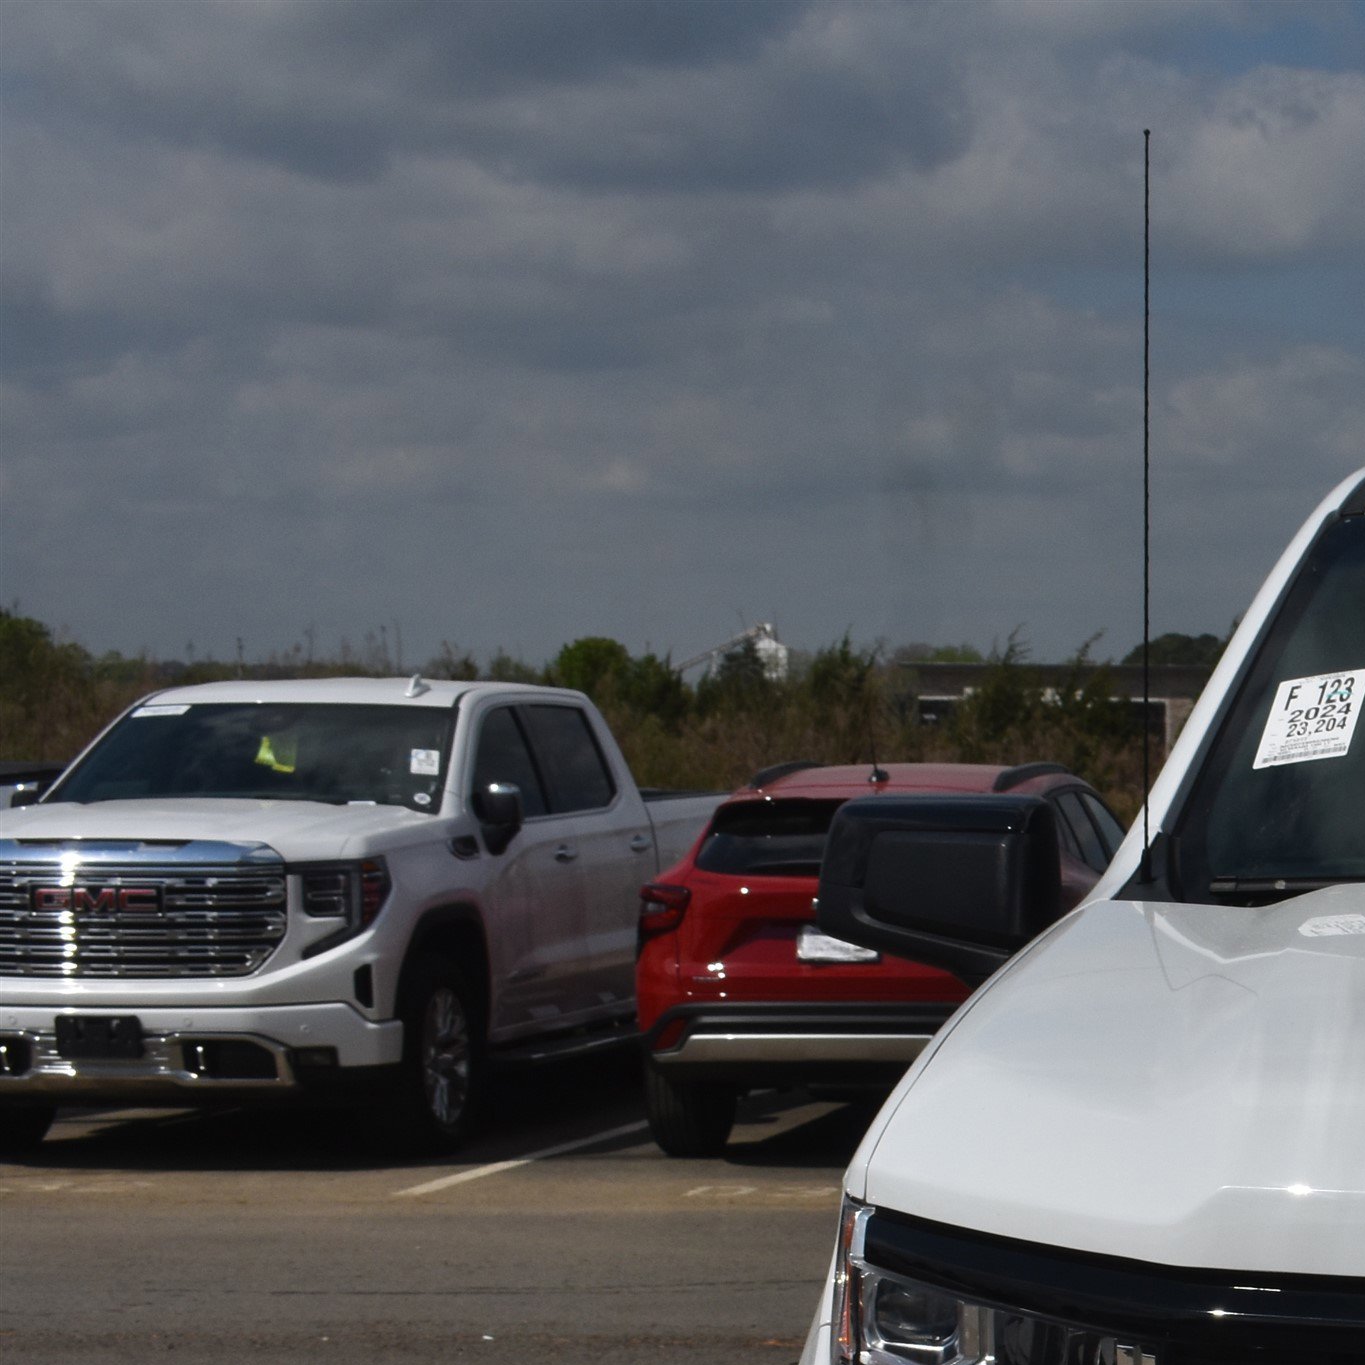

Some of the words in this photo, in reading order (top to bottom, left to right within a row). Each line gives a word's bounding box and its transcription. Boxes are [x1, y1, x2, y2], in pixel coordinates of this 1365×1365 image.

[1285, 685, 1302, 711] F
[1318, 677, 1355, 706] 123
[1288, 702, 1352, 723] 2024
[35, 888, 157, 911] GMC
